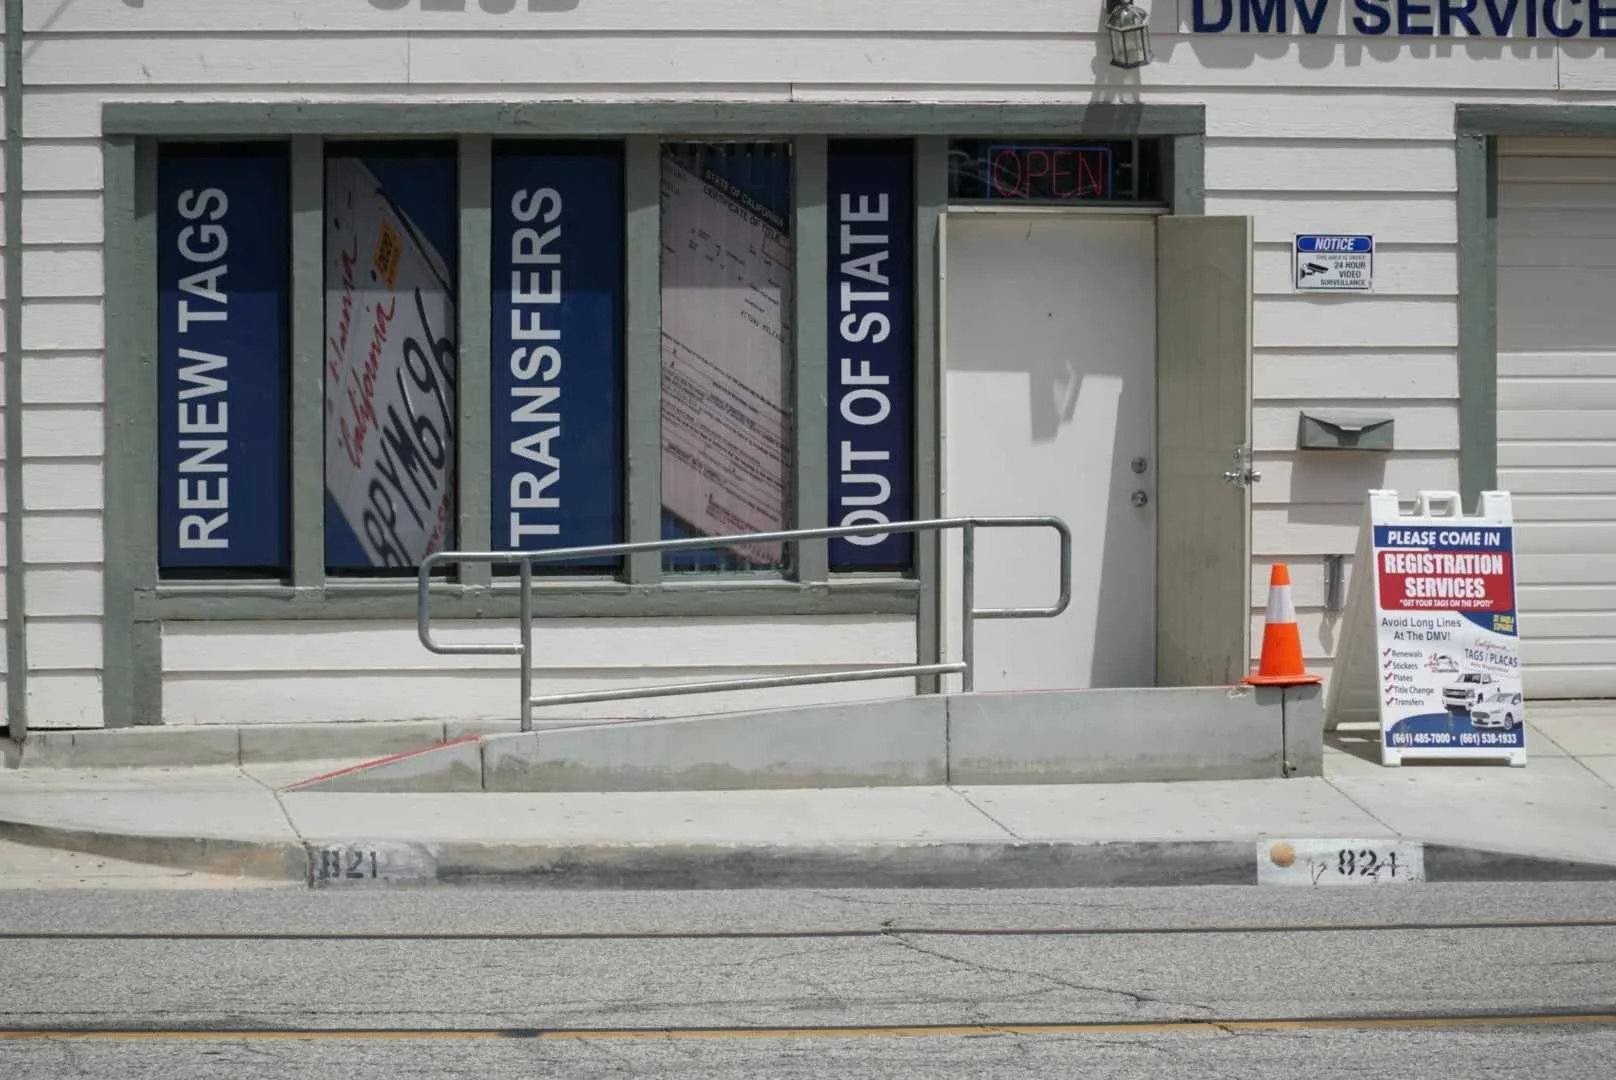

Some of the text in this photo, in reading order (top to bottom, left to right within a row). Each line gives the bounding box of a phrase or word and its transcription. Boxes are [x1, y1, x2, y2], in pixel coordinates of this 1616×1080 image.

[1192, 0, 1616, 38] DMV SERVICE
[993, 149, 1104, 197] OPEN
[1314, 237, 1355, 250] NOTICE
[1334, 261, 1366, 269] 24 HOUR
[1339, 270, 1361, 278] VIDEO
[178, 187, 229, 549] RENEW TAGS
[510, 187, 563, 547] TRANSFERS
[840, 193, 891, 546] OUT OF STATE
[1388, 531, 1500, 546] PLEASE COME IN
[1384, 553, 1503, 575] REGISTRATION
[1405, 577, 1486, 598] SERVICES
[1382, 617, 1462, 629] Avoid Long Lines
[1394, 631, 1450, 640] At The DMV!
[1391, 649, 1423, 658] Renewals
[1465, 648, 1484, 661] TAGS
[1489, 653, 1518, 668] PLACAS
[1392, 662, 1418, 670] Stickers
[1393, 674, 1413, 682] Plates
[1394, 686, 1434, 695] Title Change
[1395, 698, 1424, 707] Transfers
[1392, 733, 1413, 746] (661)
[1460, 733, 1480, 746] (661)
